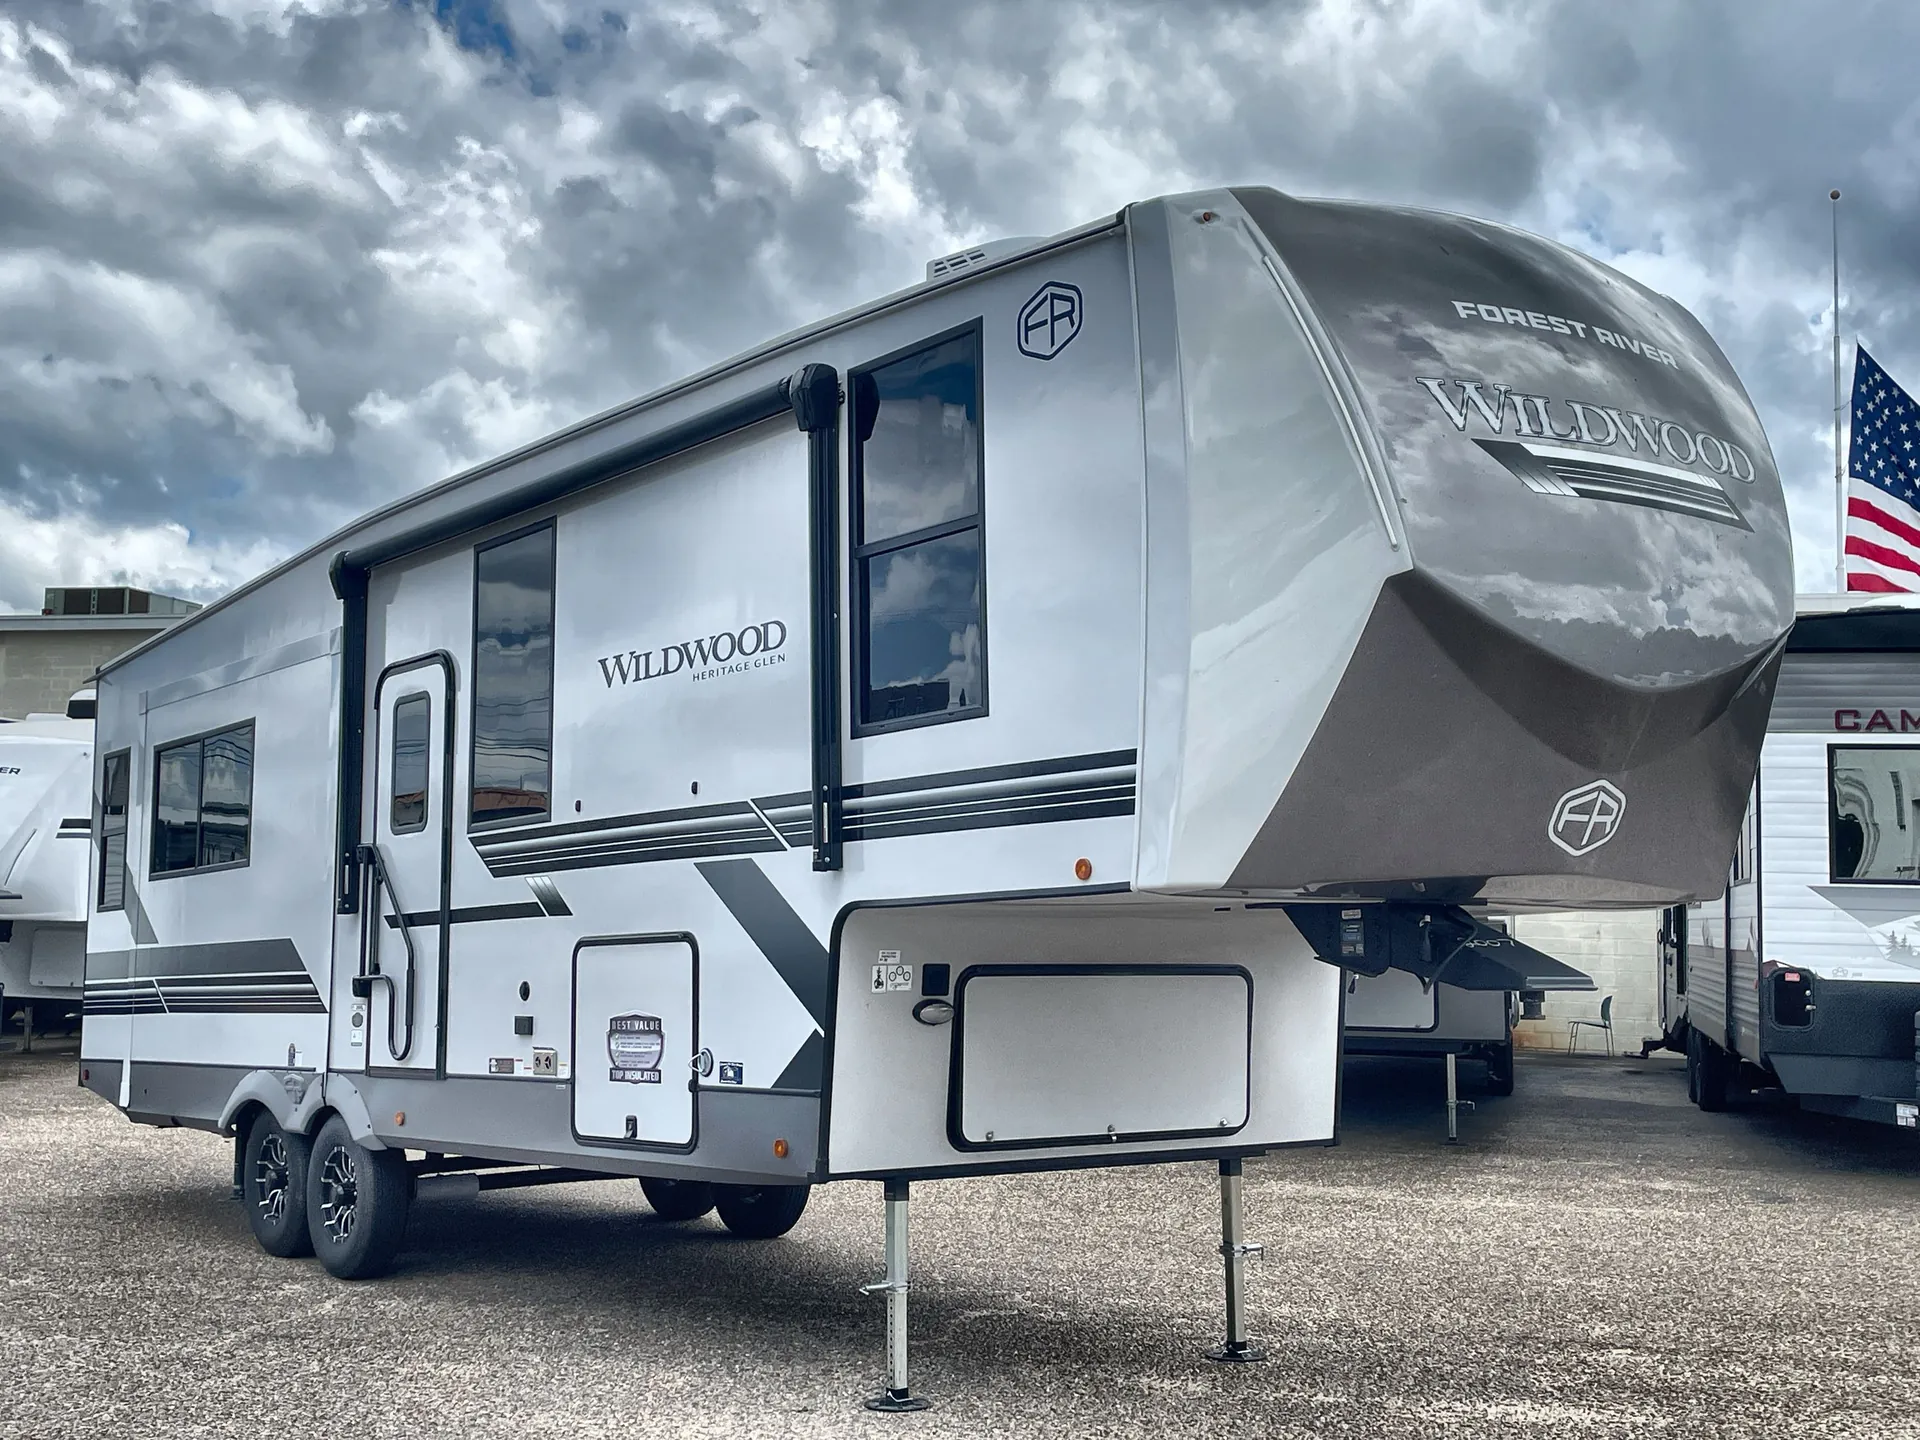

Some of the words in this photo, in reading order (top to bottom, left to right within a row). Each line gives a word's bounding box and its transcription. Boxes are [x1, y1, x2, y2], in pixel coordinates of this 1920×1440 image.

[1451, 300, 1588, 338] FOREST
[1591, 325, 1679, 369] RIVER
[1416, 376, 1757, 484] WILDWOOD
[597, 620, 787, 688] WILDWOOD
[692, 661, 750, 682] HERITAGE
[754, 653, 786, 668] GLEN
[634, 1020, 660, 1030] VALUE
[611, 1070, 624, 1080] TOP
